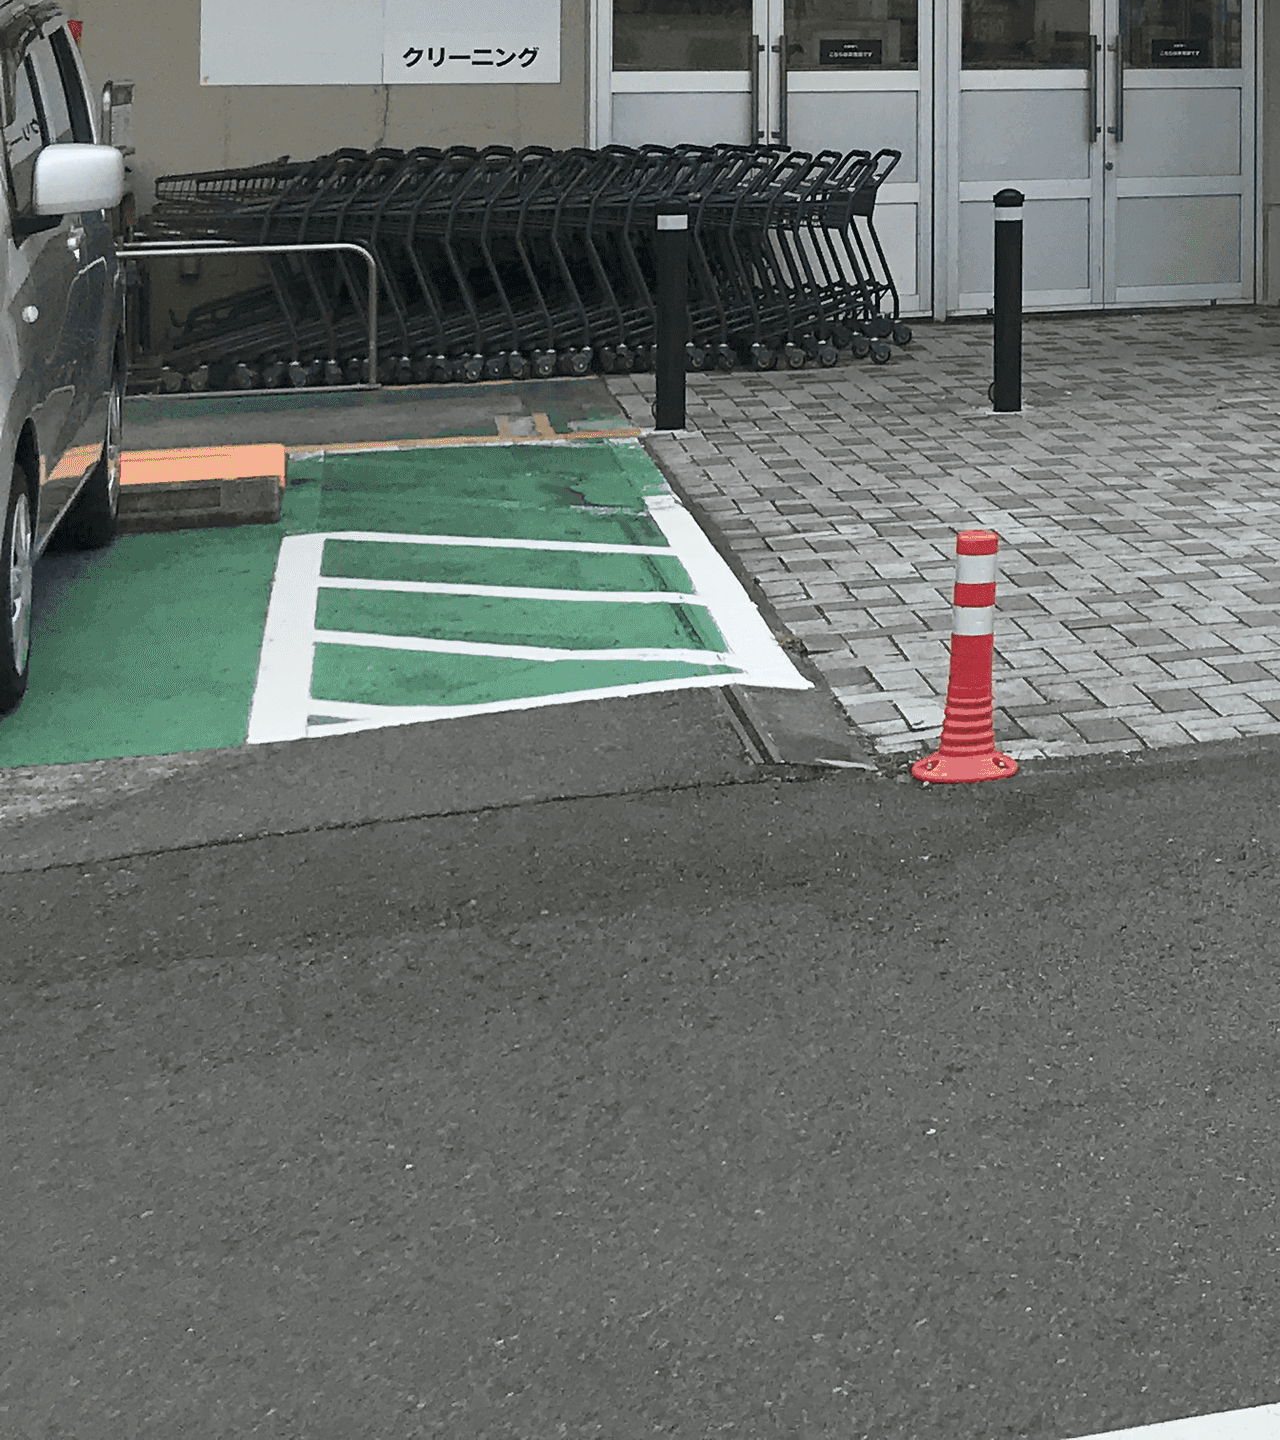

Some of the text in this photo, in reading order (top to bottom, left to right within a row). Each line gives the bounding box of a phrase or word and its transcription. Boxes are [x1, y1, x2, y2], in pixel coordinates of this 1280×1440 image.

[403, 47, 540, 68] クリーニング
